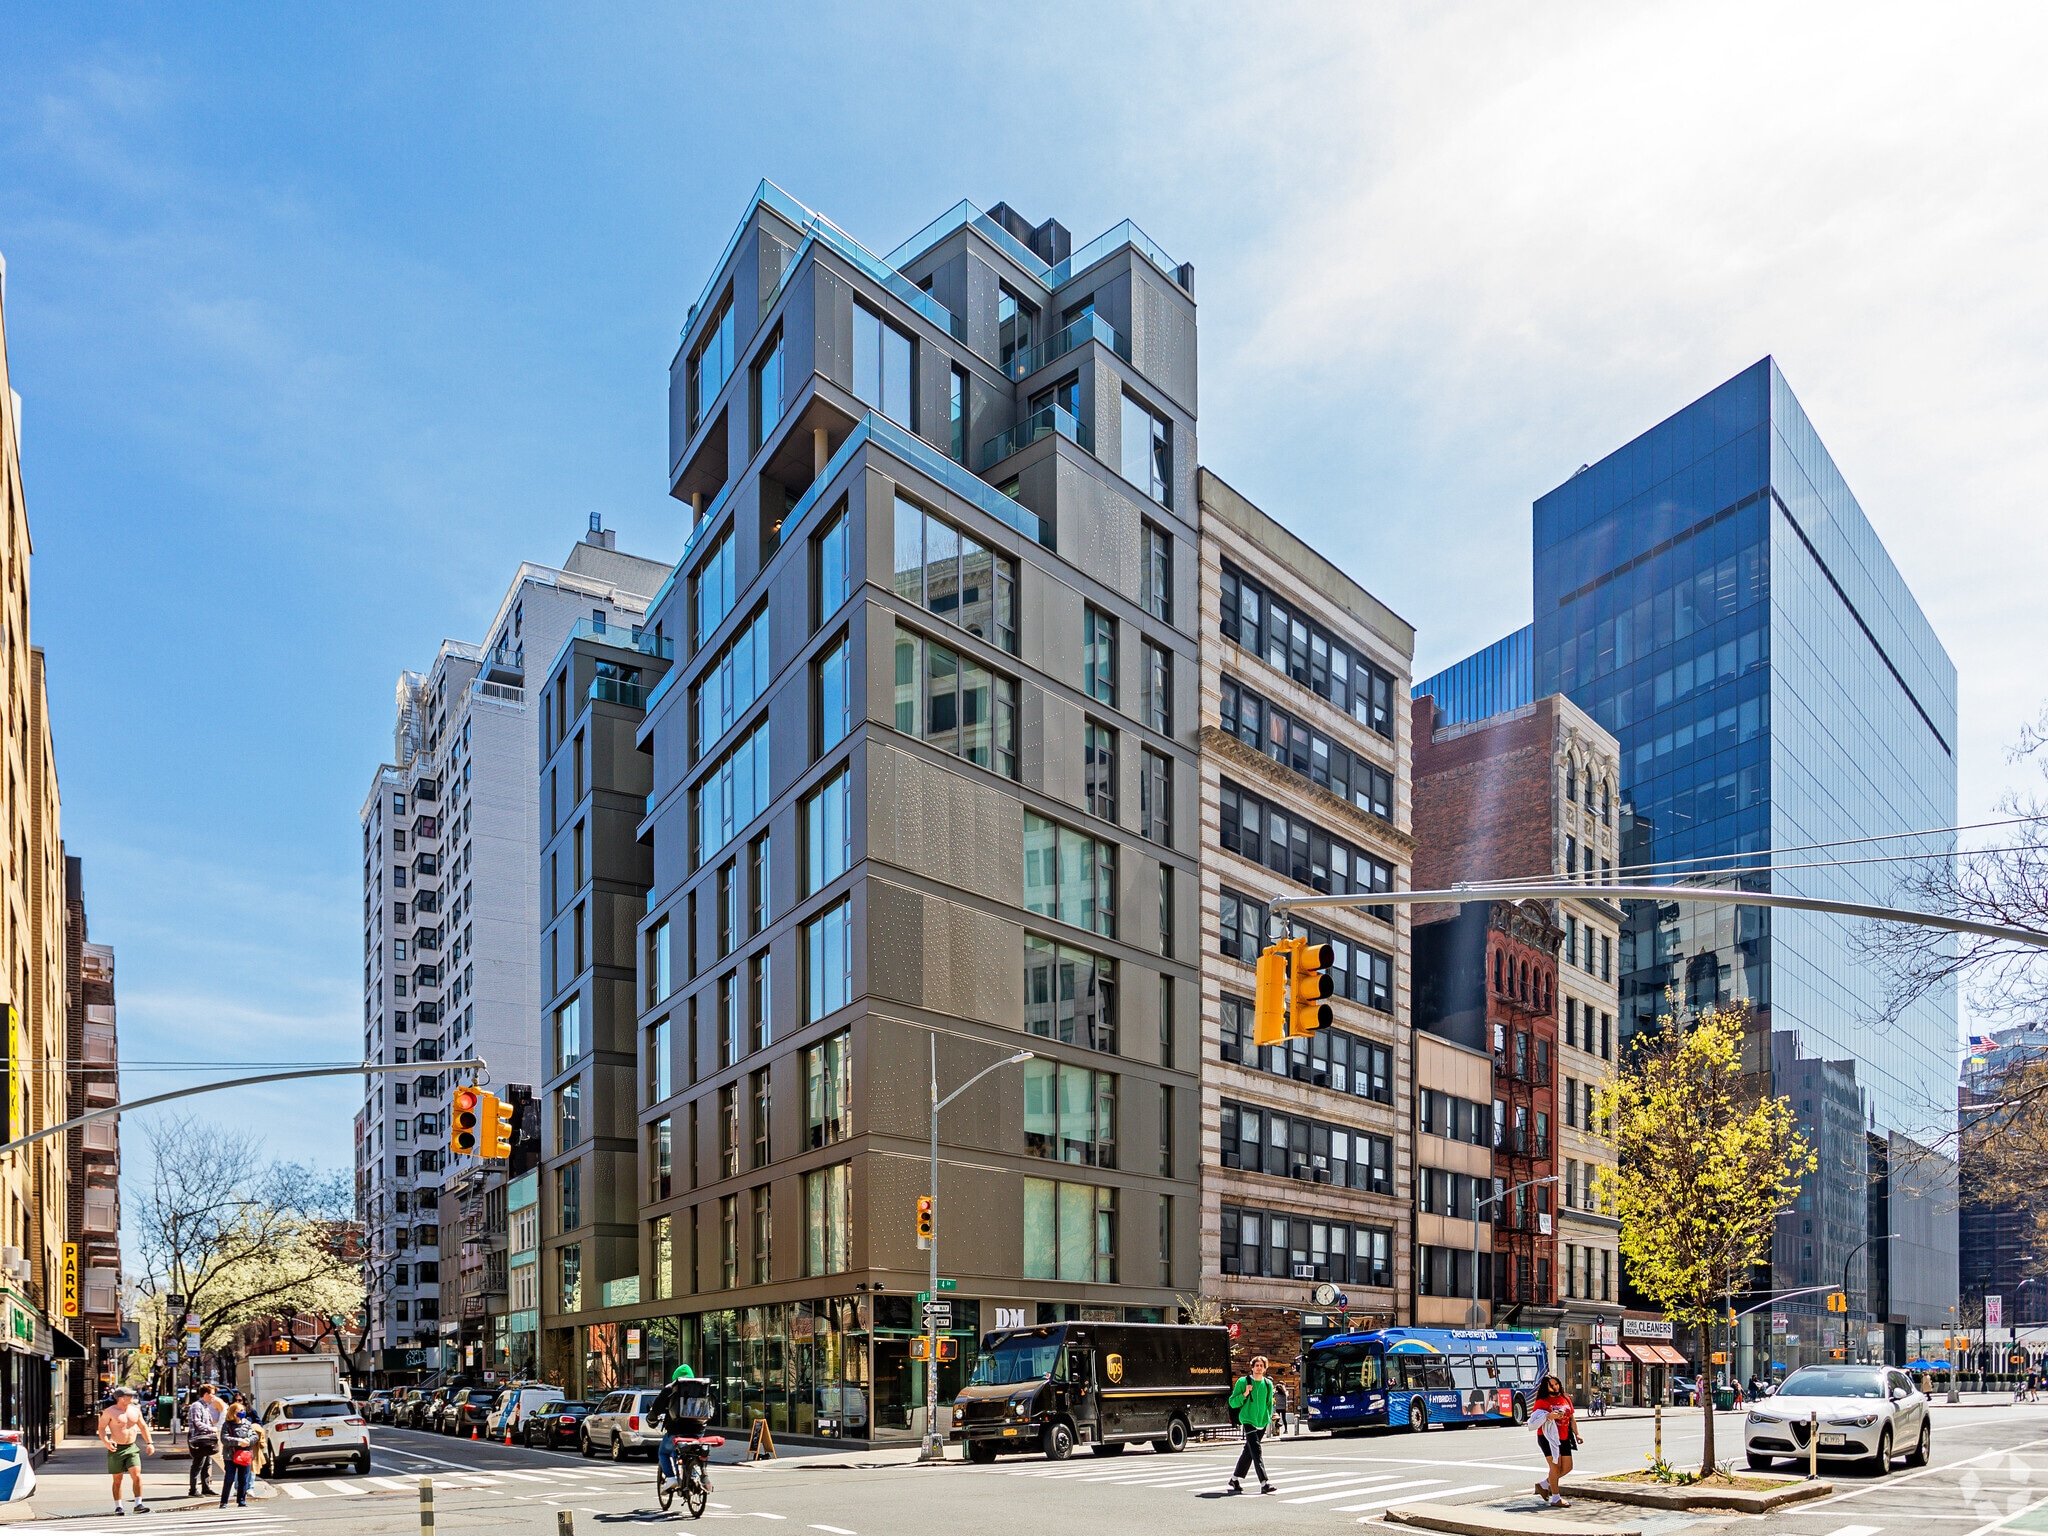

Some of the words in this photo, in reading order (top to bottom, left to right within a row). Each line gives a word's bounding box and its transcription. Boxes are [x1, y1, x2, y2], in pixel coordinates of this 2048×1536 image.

[65, 1246, 75, 1300] PARK
[941, 1280, 945, 1289] 4
[995, 1308, 1025, 1328] DM
[1639, 1321, 1671, 1334] CLEANERS
[1109, 1363, 1121, 1379] ups
[1433, 1395, 1456, 1404] HYBRIDBUS
